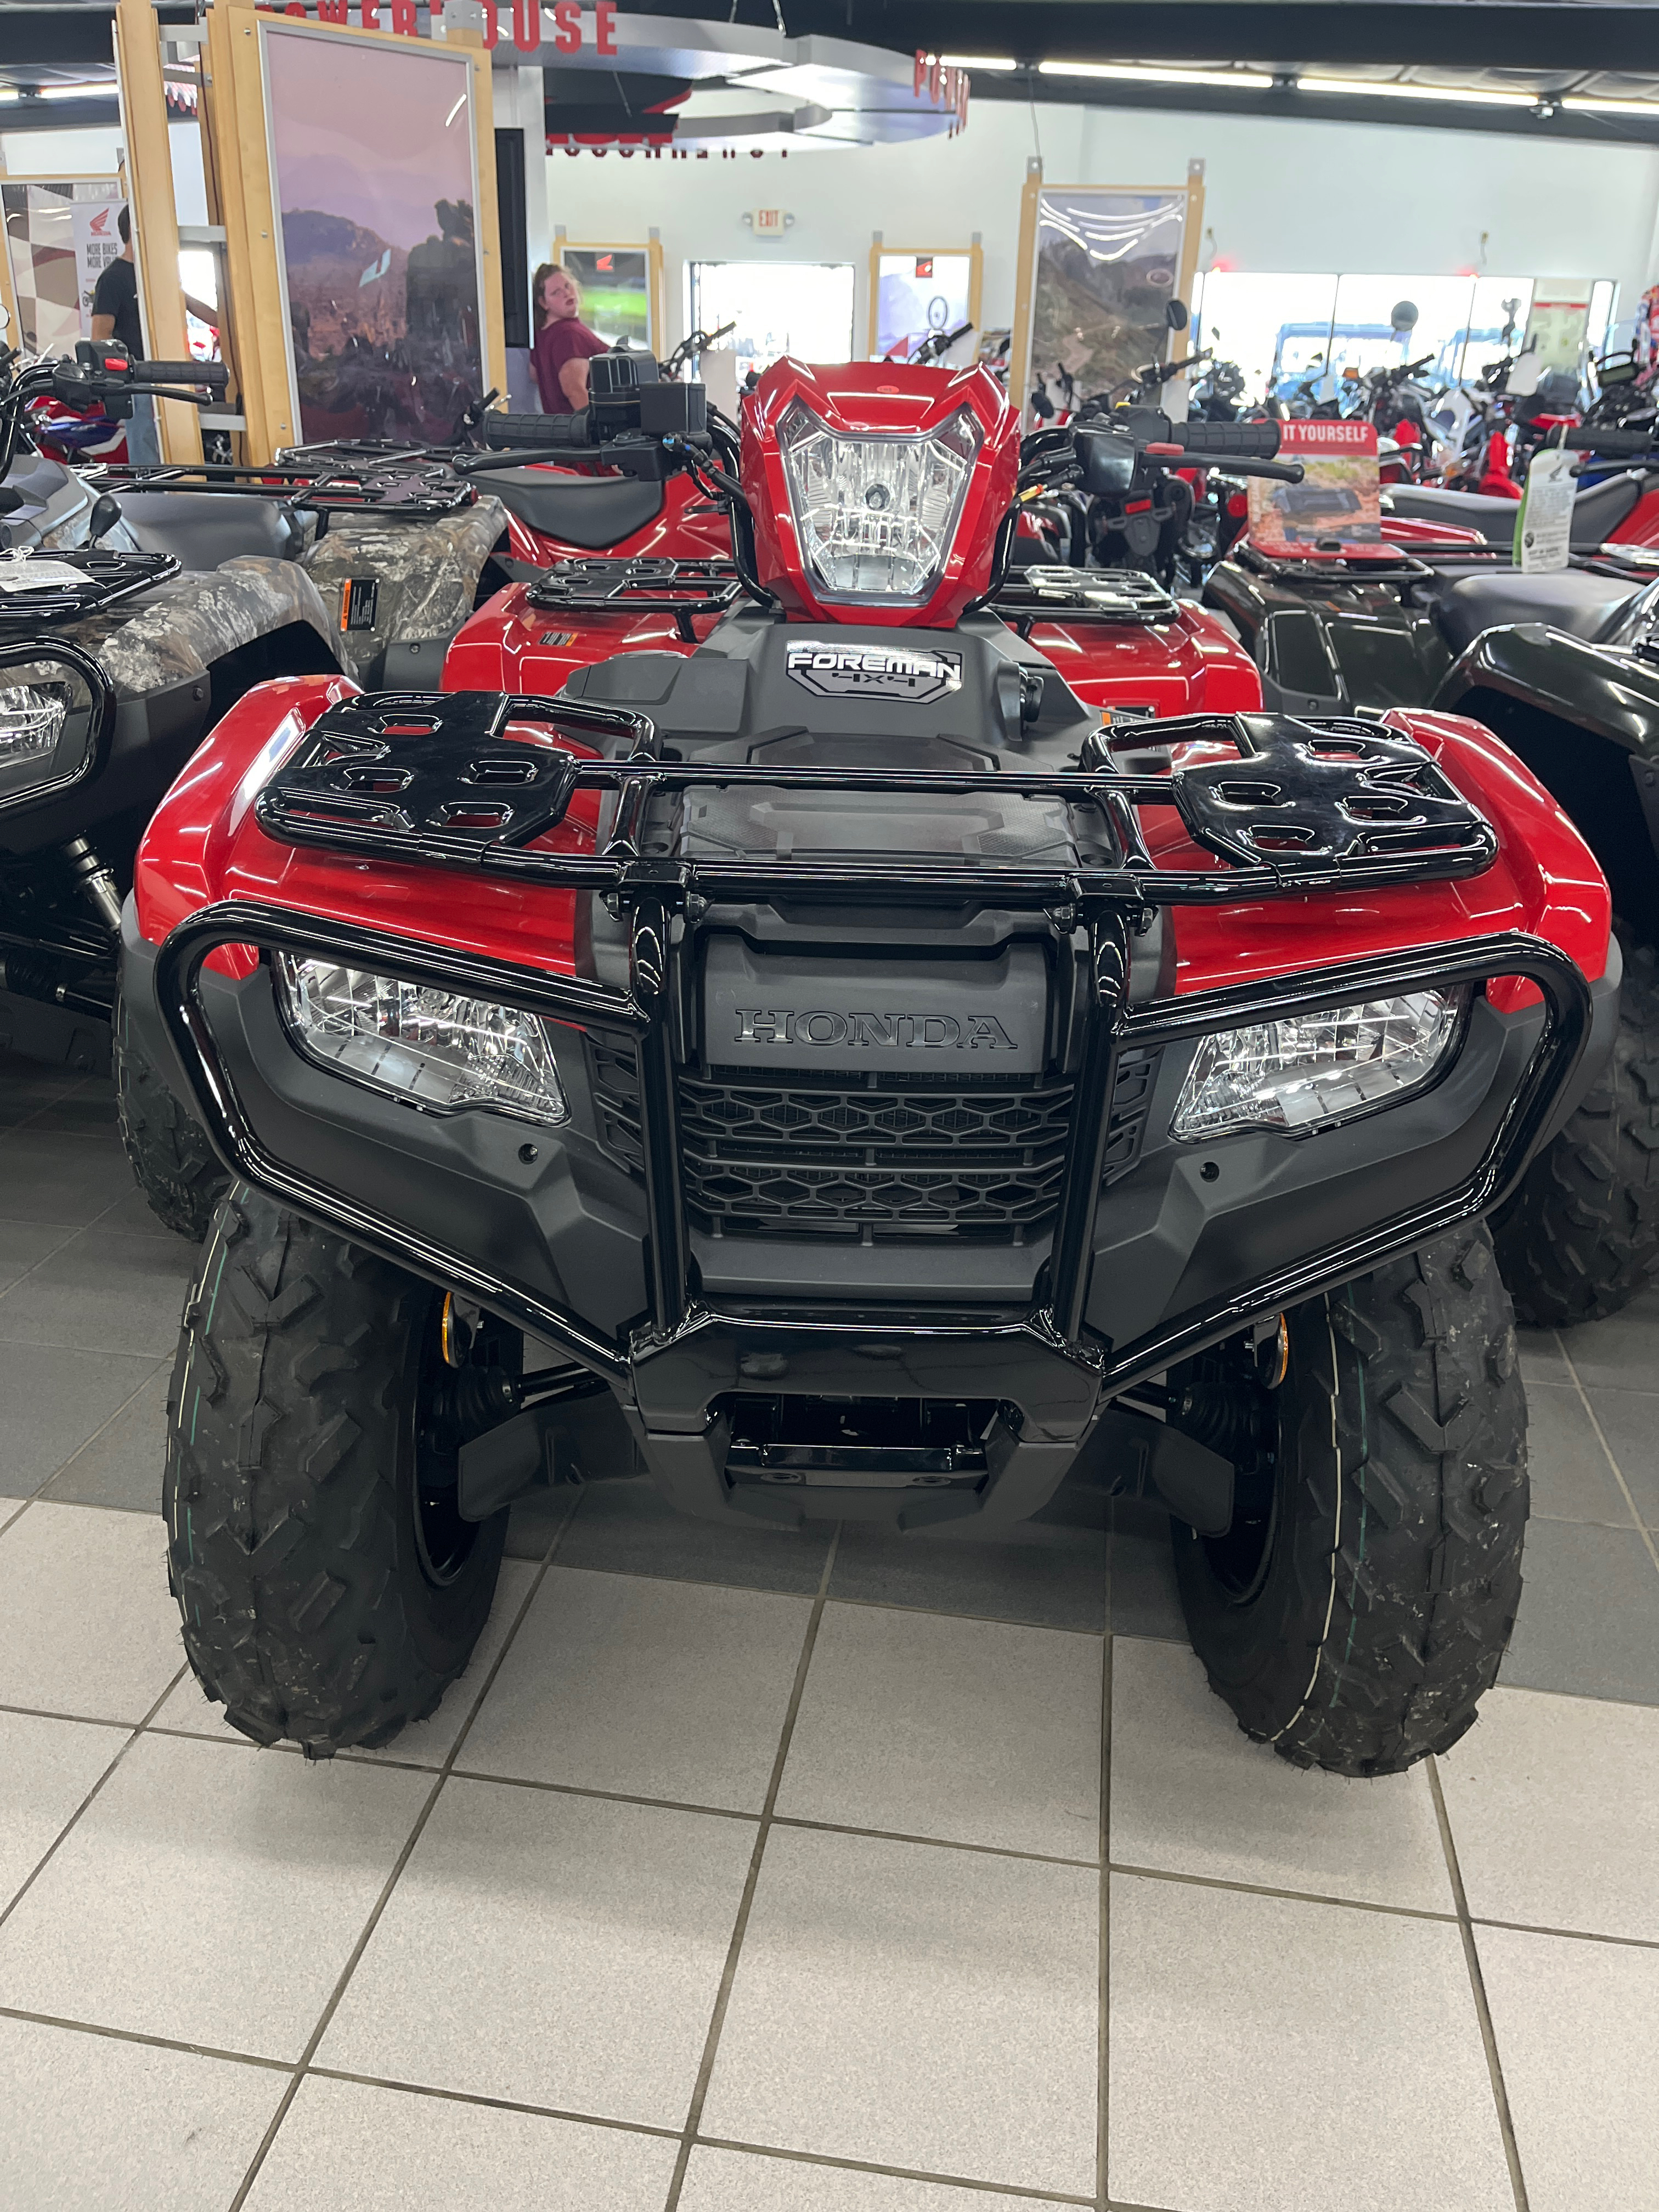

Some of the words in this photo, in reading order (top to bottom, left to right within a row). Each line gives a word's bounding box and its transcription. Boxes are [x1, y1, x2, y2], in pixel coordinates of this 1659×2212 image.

[759, 210, 778, 227] EXIT
[87, 243, 101, 255] MORE
[87, 256, 101, 268] MORE
[1283, 424, 1295, 439] IT
[1297, 425, 1369, 442] YOURSELF
[788, 653, 961, 680] FOREMAN
[734, 1009, 1018, 1049] HONDA
